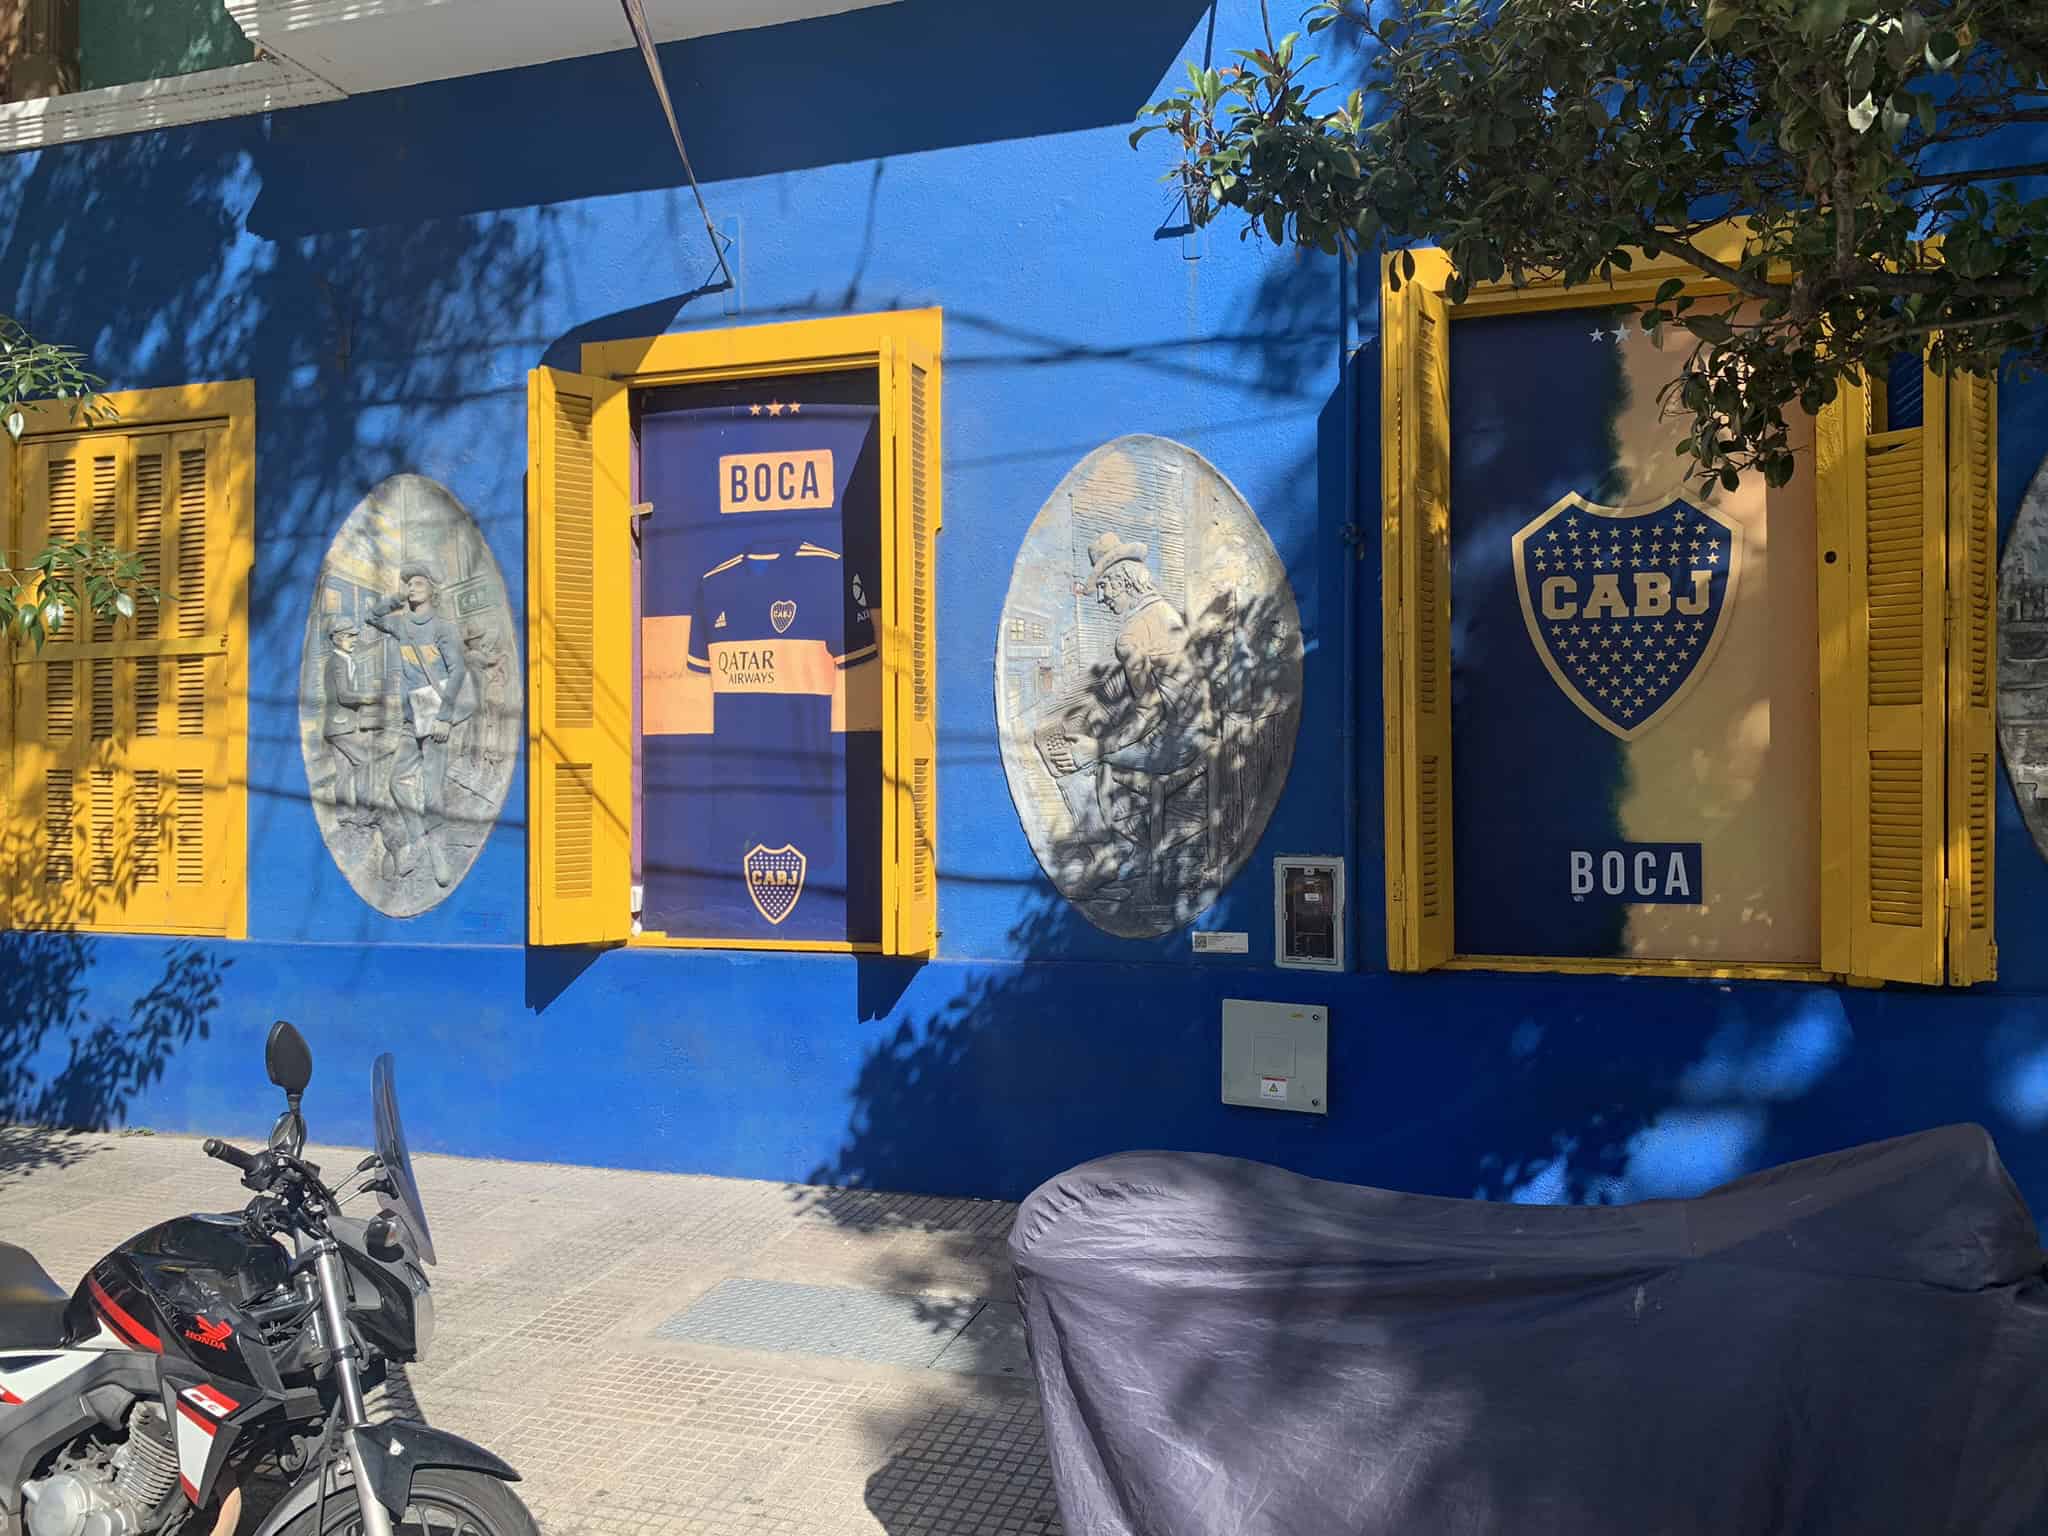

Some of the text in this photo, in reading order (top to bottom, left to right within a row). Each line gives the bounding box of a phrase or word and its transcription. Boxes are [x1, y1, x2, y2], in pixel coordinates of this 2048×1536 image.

[730, 460, 820, 503] BOCA
[1541, 569, 1712, 620] CABJ
[718, 650, 775, 674] QATAR
[728, 672, 775, 685] AIRWAYS
[751, 870, 798, 886] CABJ
[1570, 850, 1690, 896] BOCA
[185, 1329, 227, 1351] HONDA
